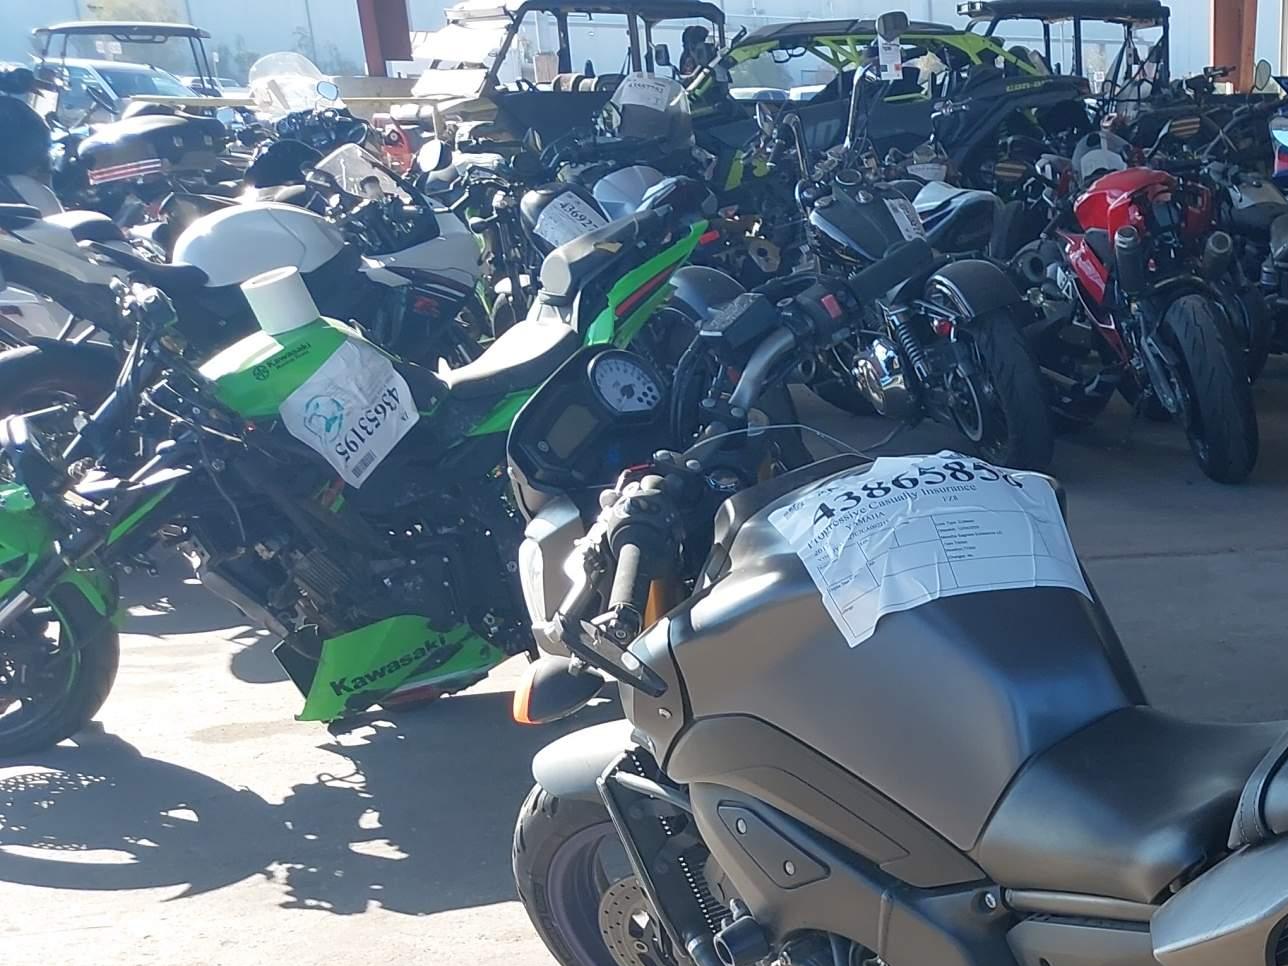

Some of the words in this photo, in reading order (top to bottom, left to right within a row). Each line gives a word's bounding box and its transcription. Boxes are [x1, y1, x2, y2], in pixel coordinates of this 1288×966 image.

[335, 387, 401, 462] 43653195
[920, 484, 977, 497] Insurance
[329, 634, 446, 697] Kawasaki
